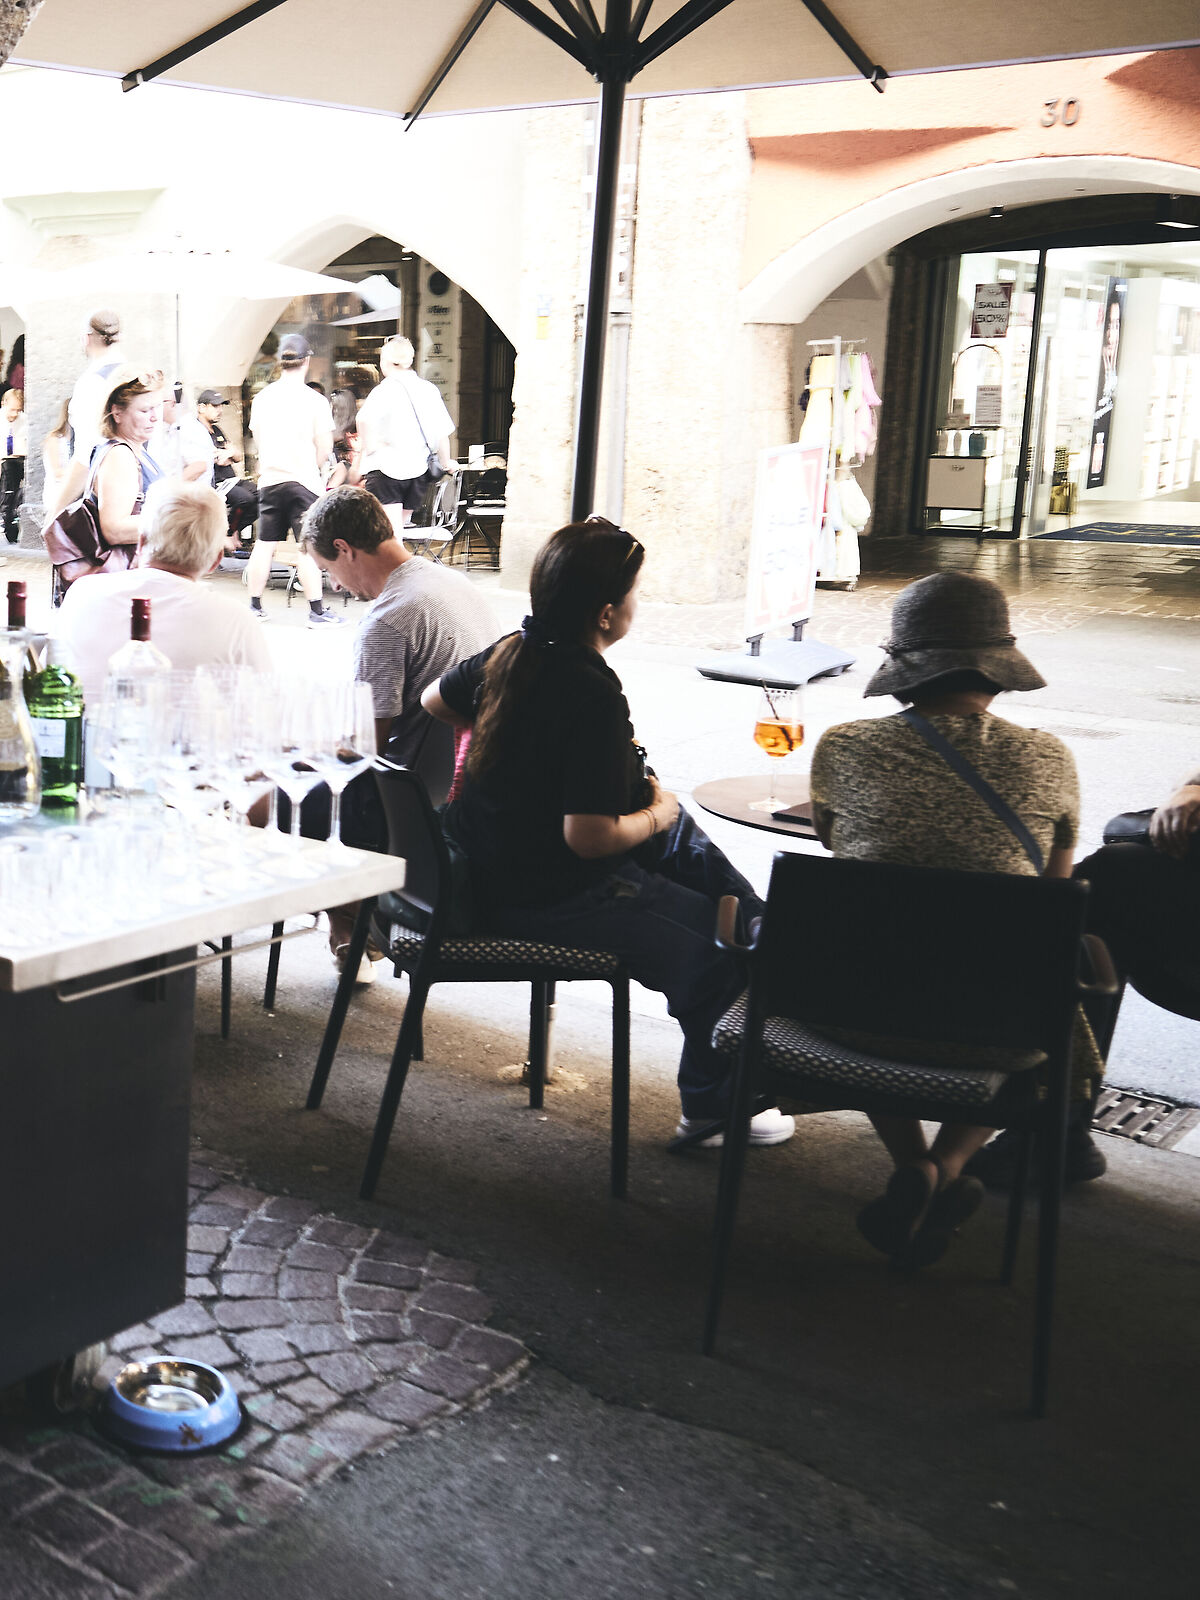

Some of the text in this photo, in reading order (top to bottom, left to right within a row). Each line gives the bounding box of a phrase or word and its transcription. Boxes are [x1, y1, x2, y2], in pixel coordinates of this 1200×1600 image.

[1040, 97, 1080, 128] 30
[976, 301, 1008, 309] SALE
[975, 313, 1007, 324] 50%
